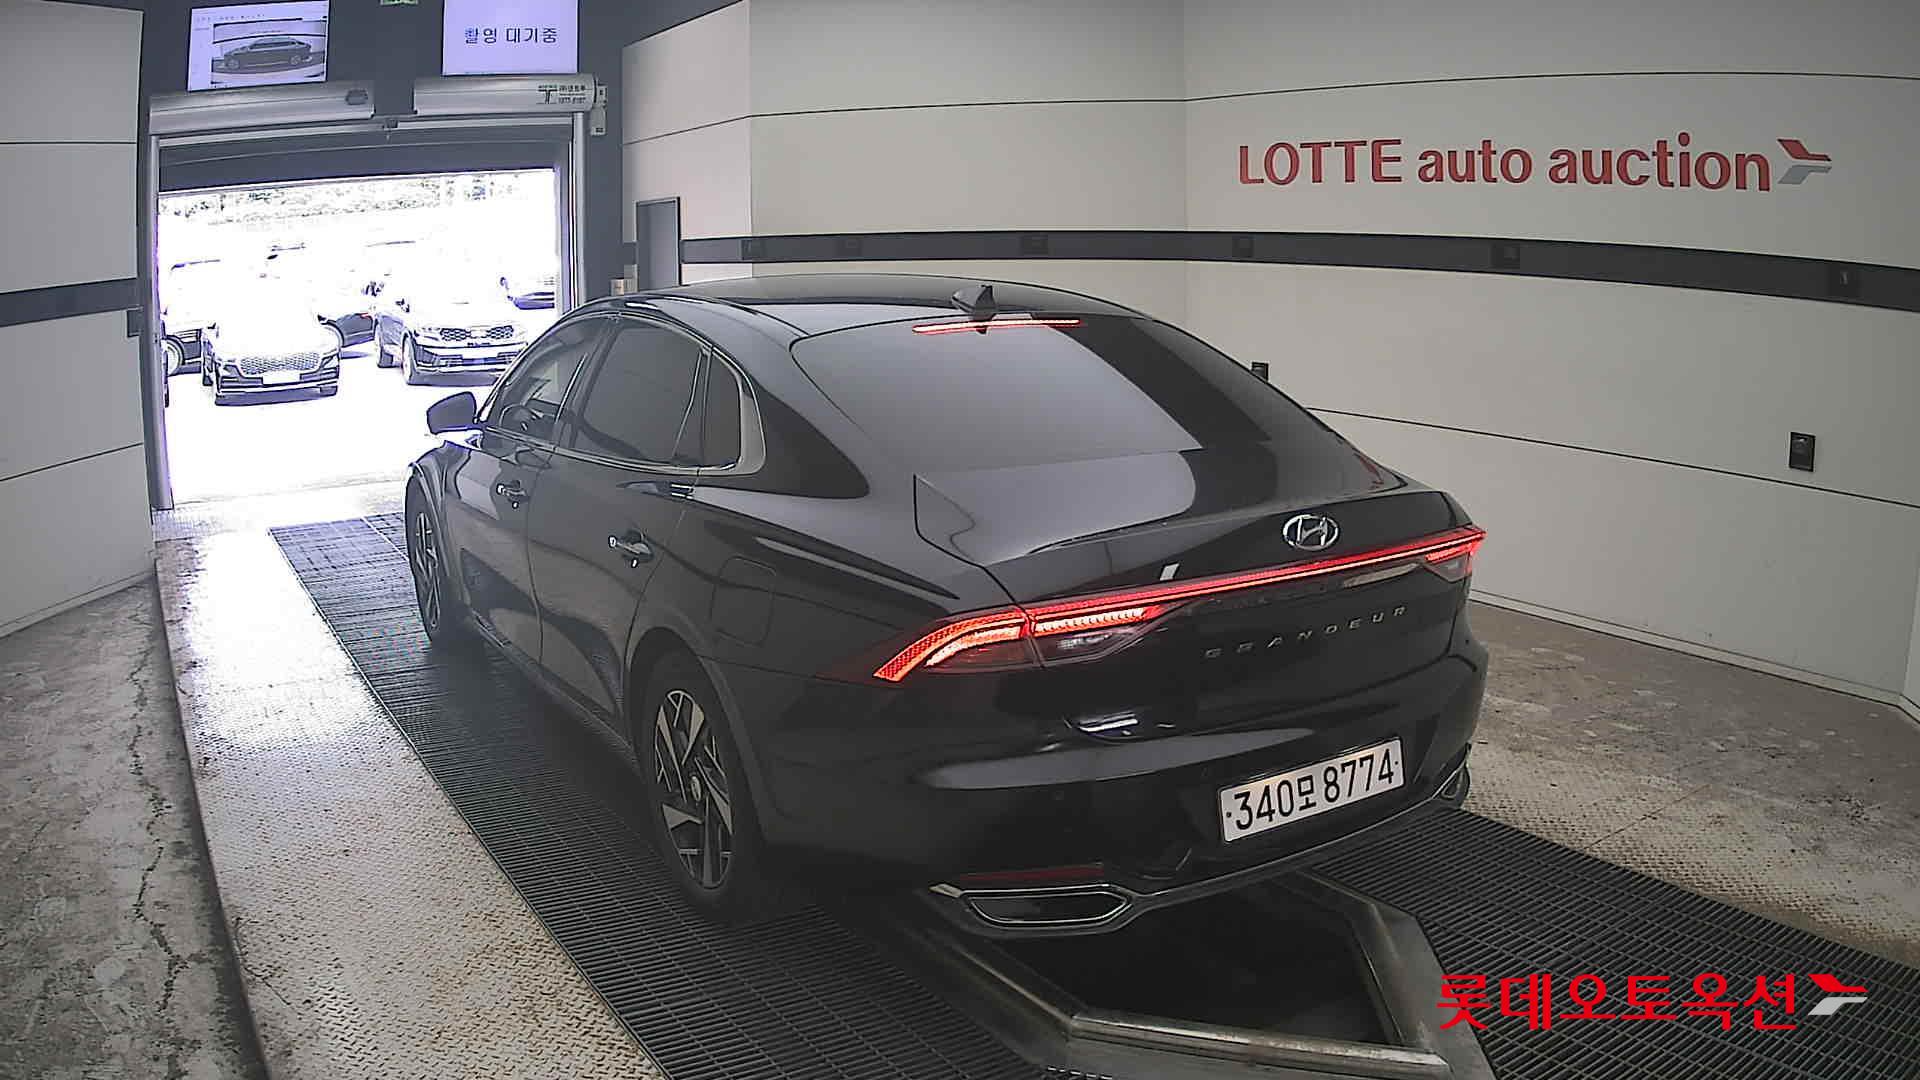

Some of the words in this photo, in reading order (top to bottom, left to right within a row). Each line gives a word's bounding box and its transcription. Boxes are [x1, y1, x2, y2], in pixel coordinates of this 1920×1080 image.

[505, 27, 558, 44] 대기중
[1239, 138, 1402, 184] LOTTE
[1418, 139, 1533, 183] auto
[1548, 131, 1771, 191] auction
[1204, 605, 1406, 658] GRANDEUR
